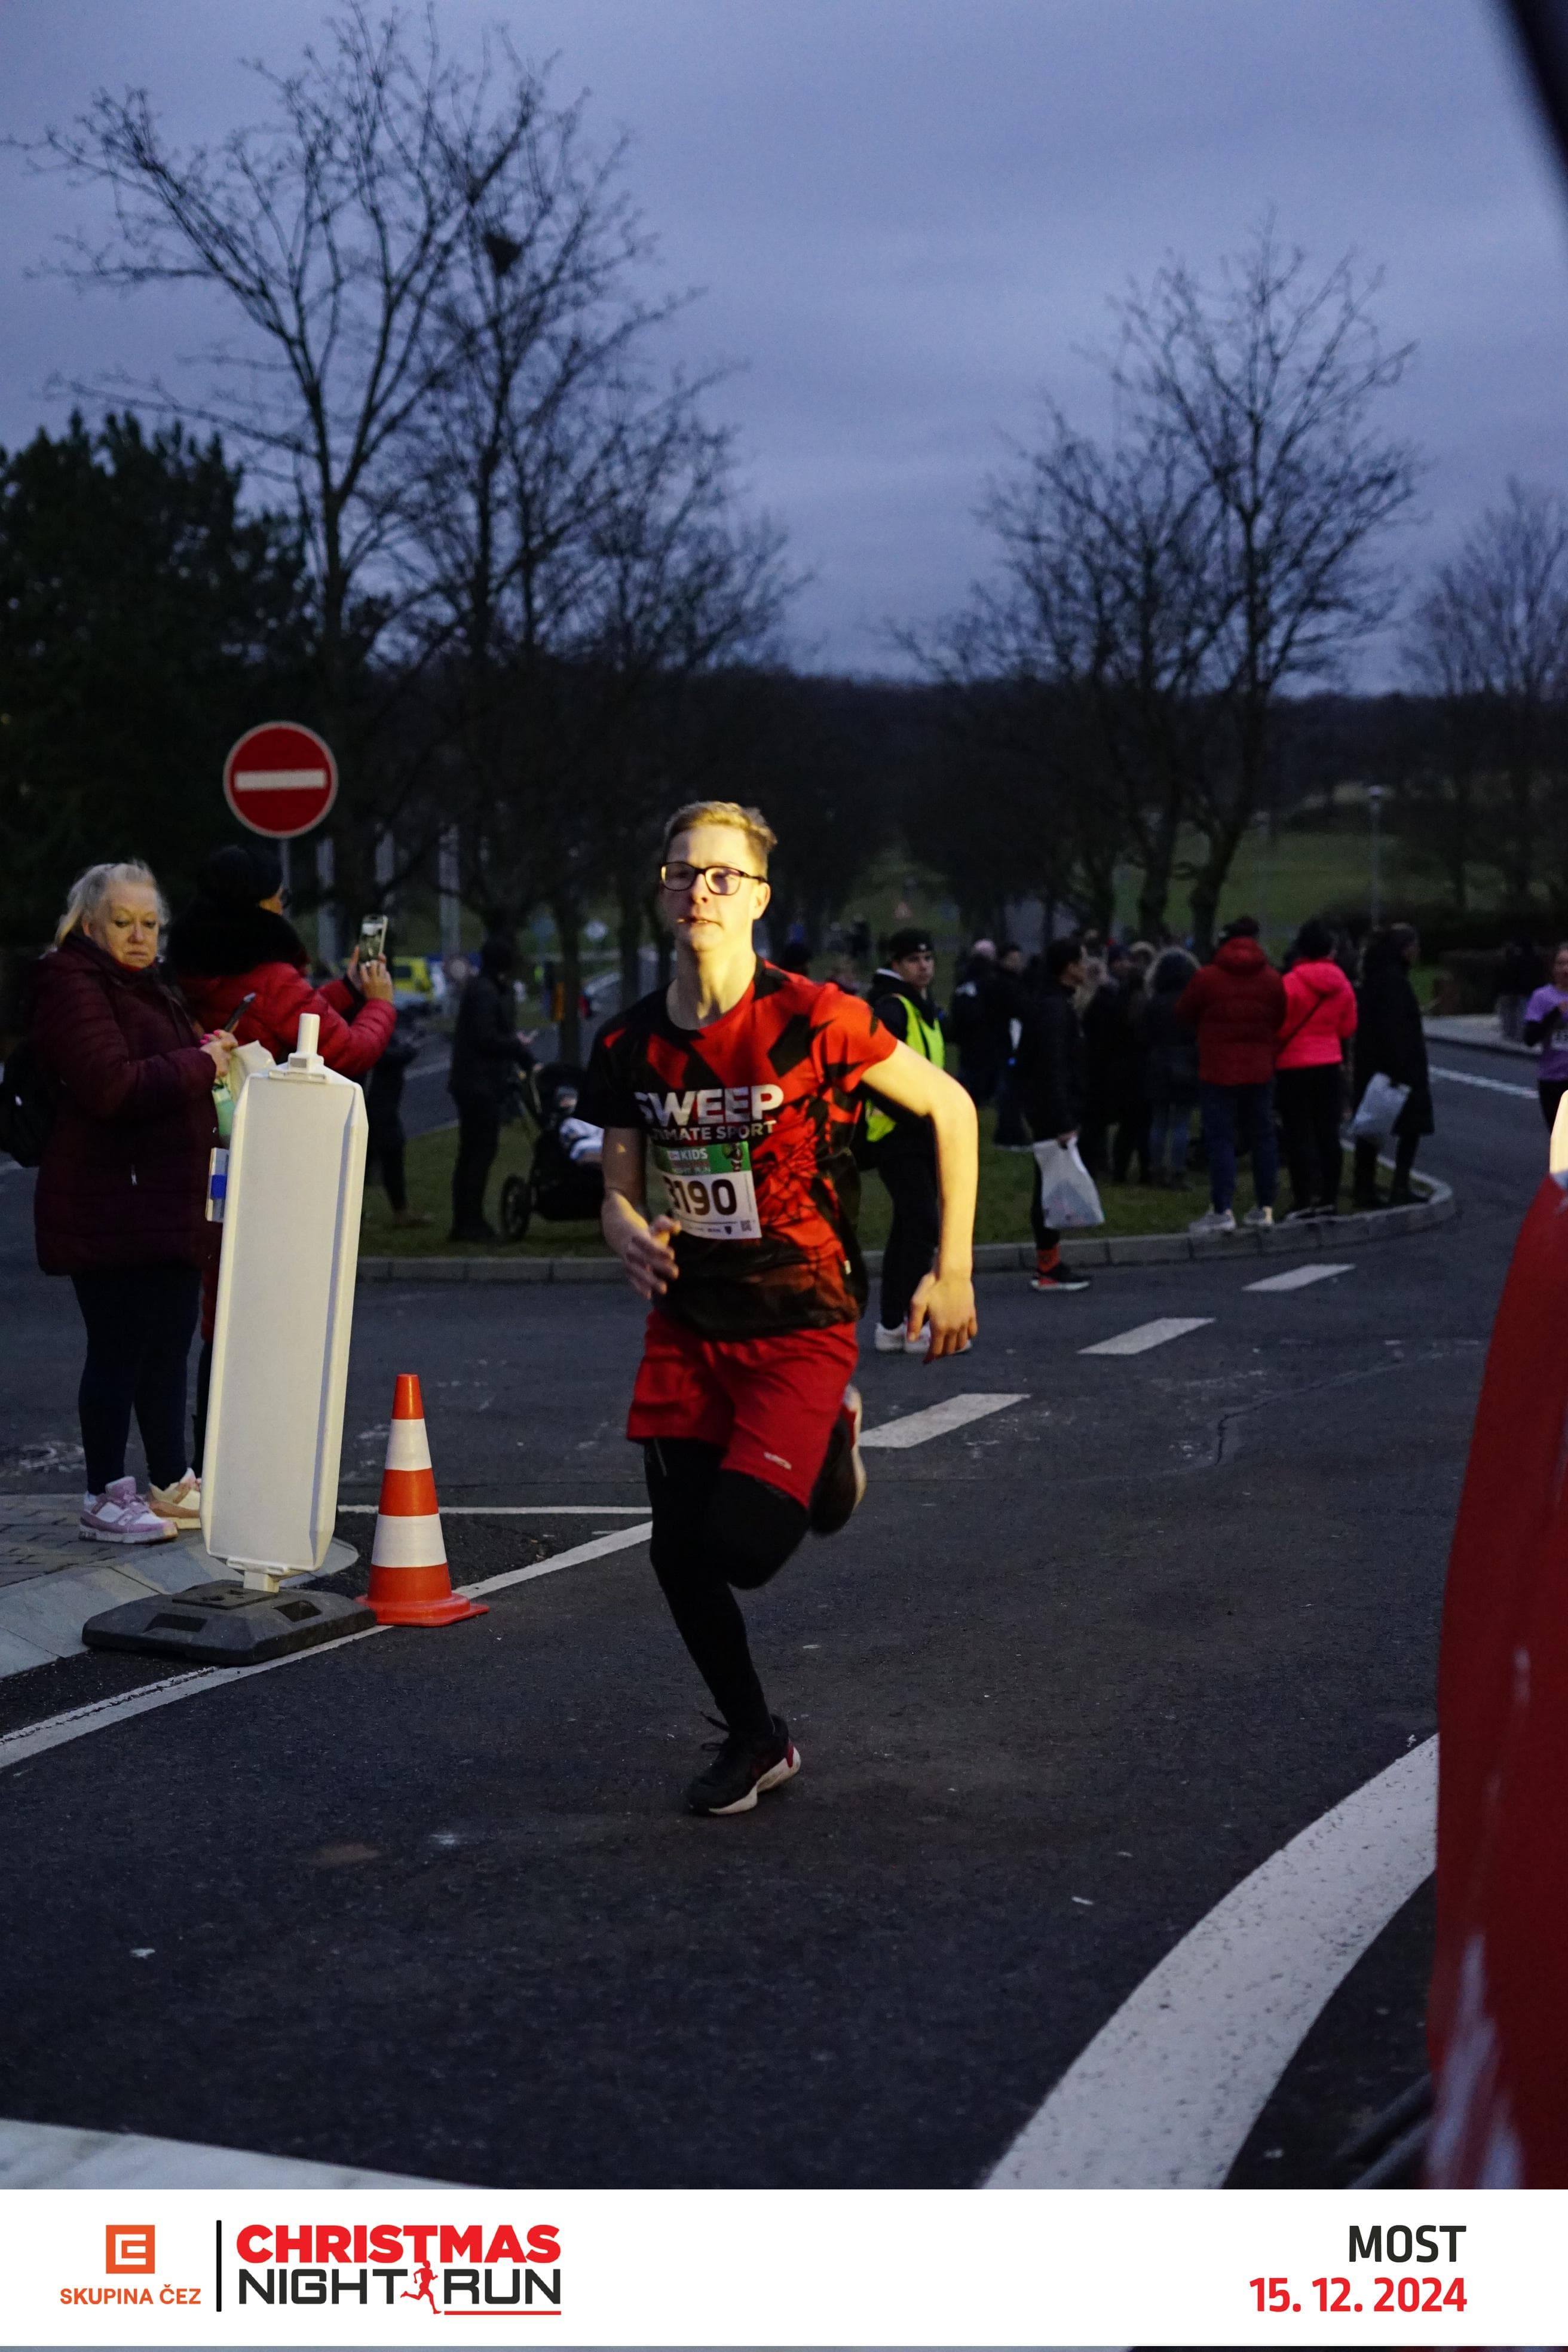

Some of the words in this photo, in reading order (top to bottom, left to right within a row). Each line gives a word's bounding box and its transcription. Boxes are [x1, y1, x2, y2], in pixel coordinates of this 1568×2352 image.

[635, 1084, 785, 1127] SWEEP
[716, 1120, 777, 1140] SPORT
[680, 1147, 709, 1160] KIDS
